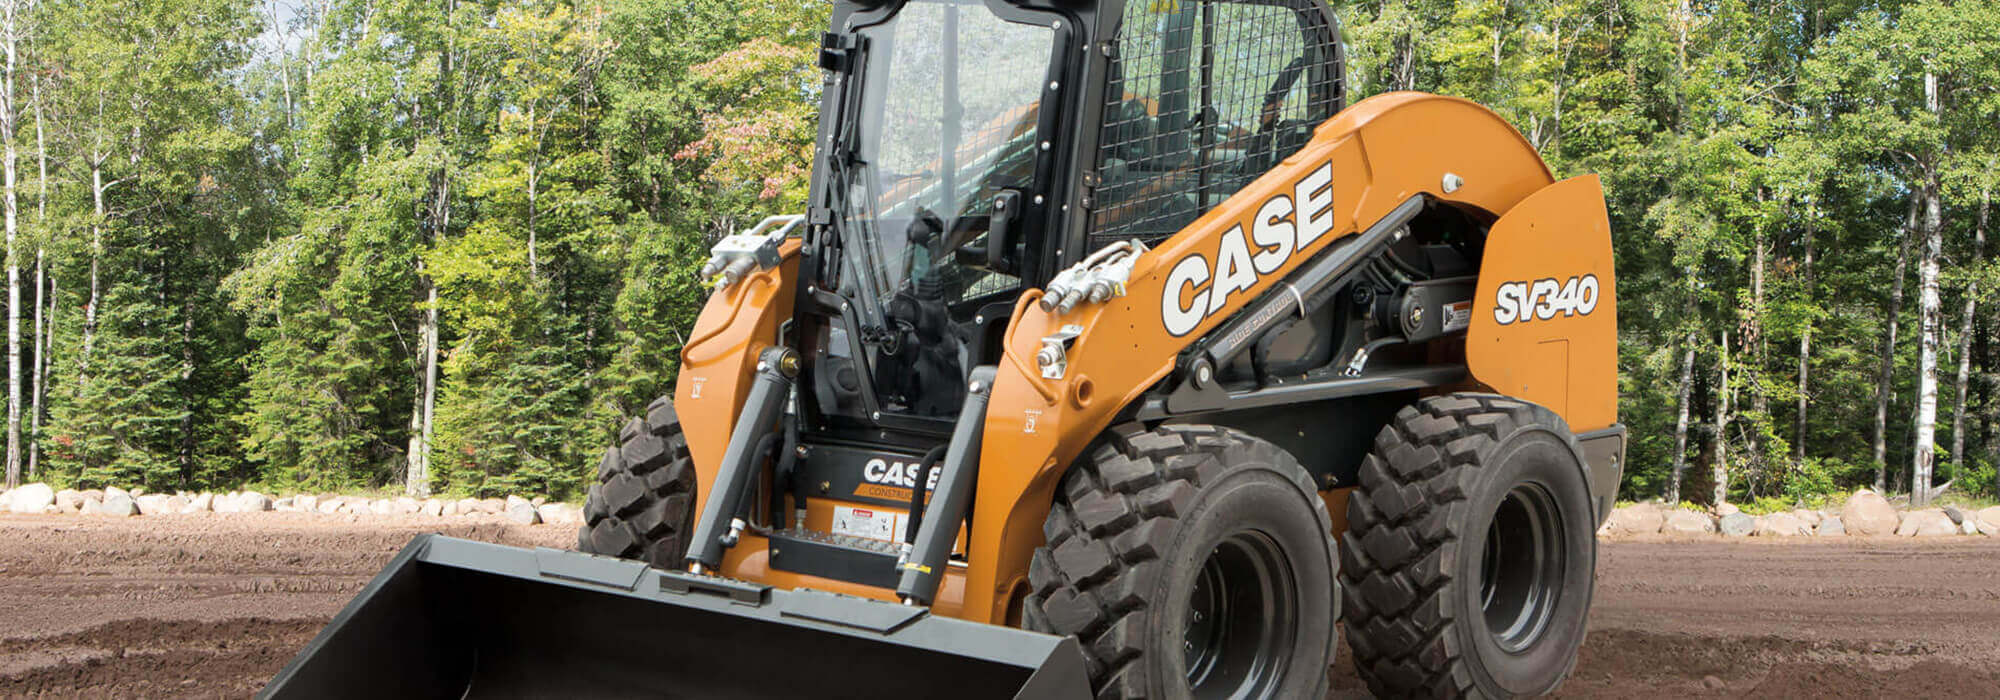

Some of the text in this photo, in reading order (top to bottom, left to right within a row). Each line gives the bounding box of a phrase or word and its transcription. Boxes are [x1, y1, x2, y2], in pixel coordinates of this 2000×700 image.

[1161, 160, 1334, 337] CASE
[1494, 274, 1599, 325] SV340
[864, 459, 941, 489] CASE
